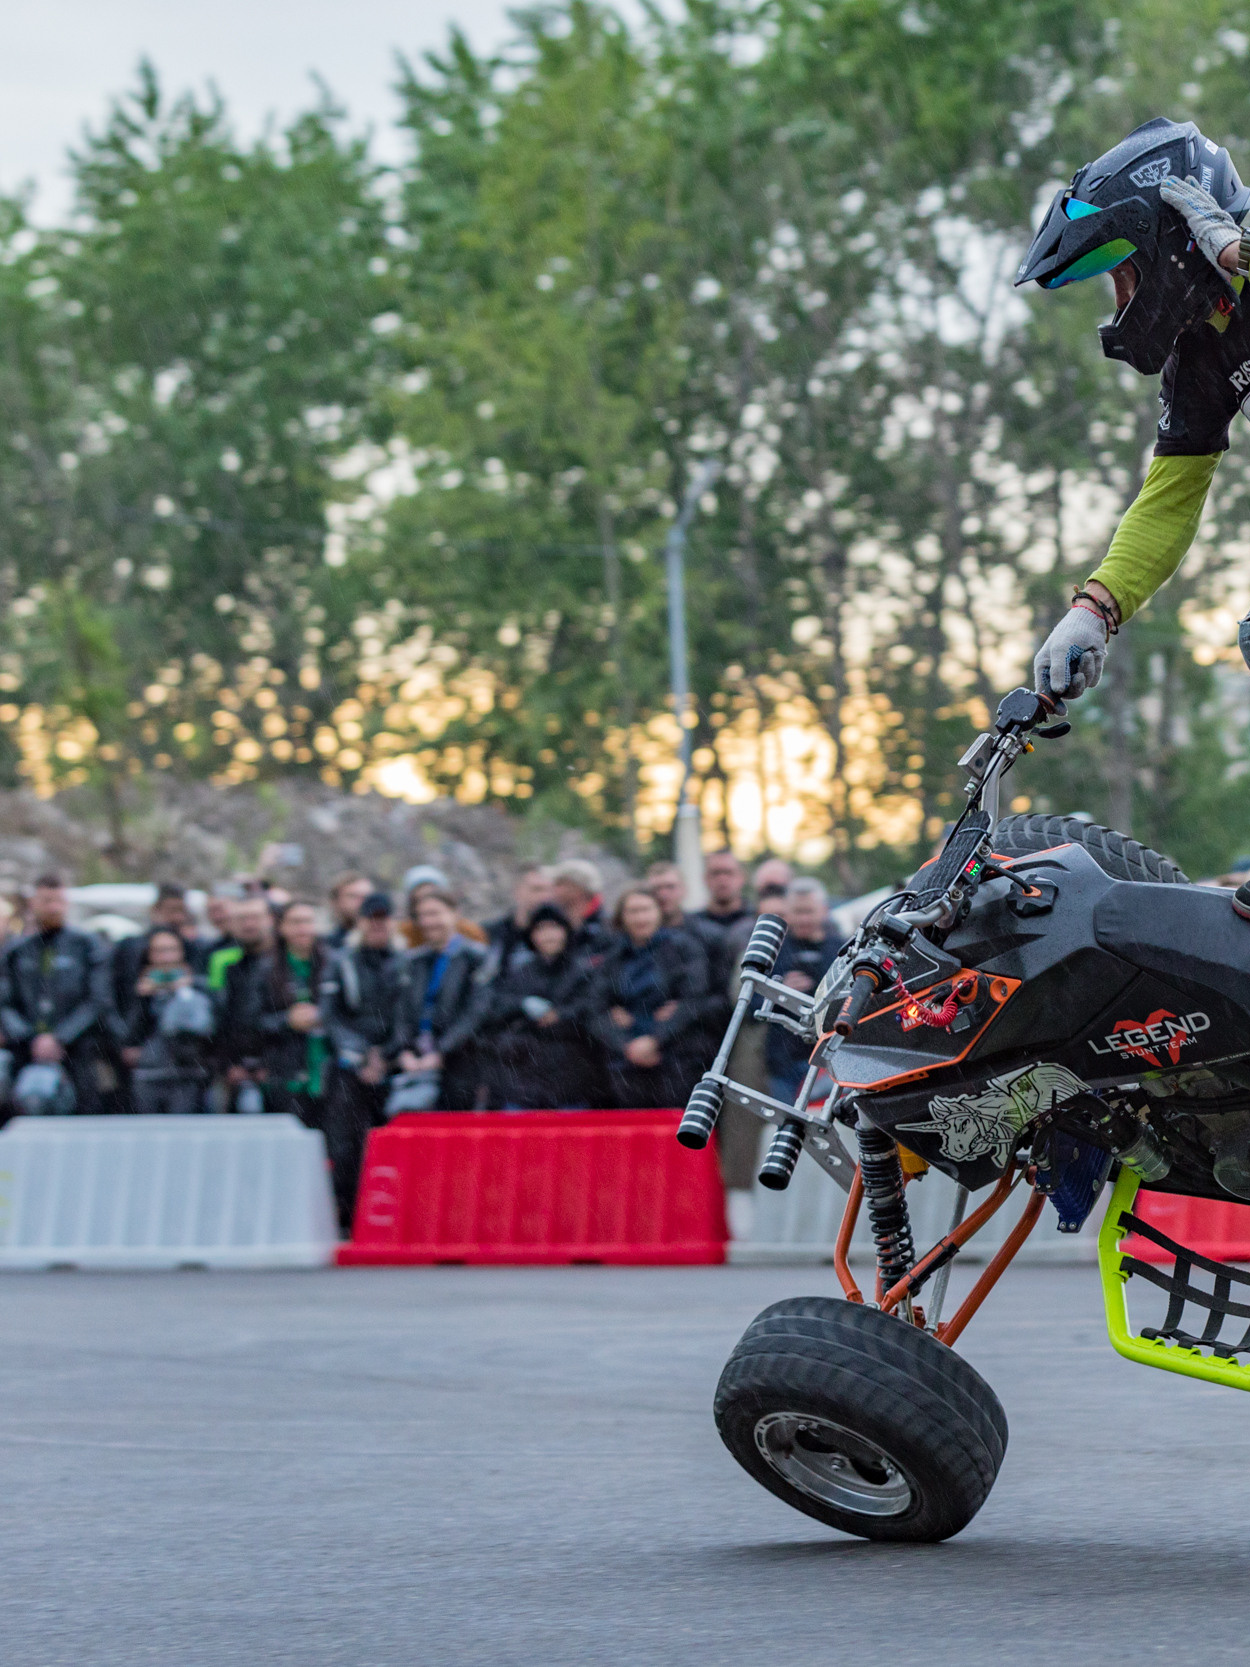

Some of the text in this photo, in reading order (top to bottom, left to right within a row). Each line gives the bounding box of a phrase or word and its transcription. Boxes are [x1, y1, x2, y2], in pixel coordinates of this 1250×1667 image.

[1088, 1012, 1210, 1054] LEGEND
[1120, 1036, 1198, 1059] STUNT TEAM
